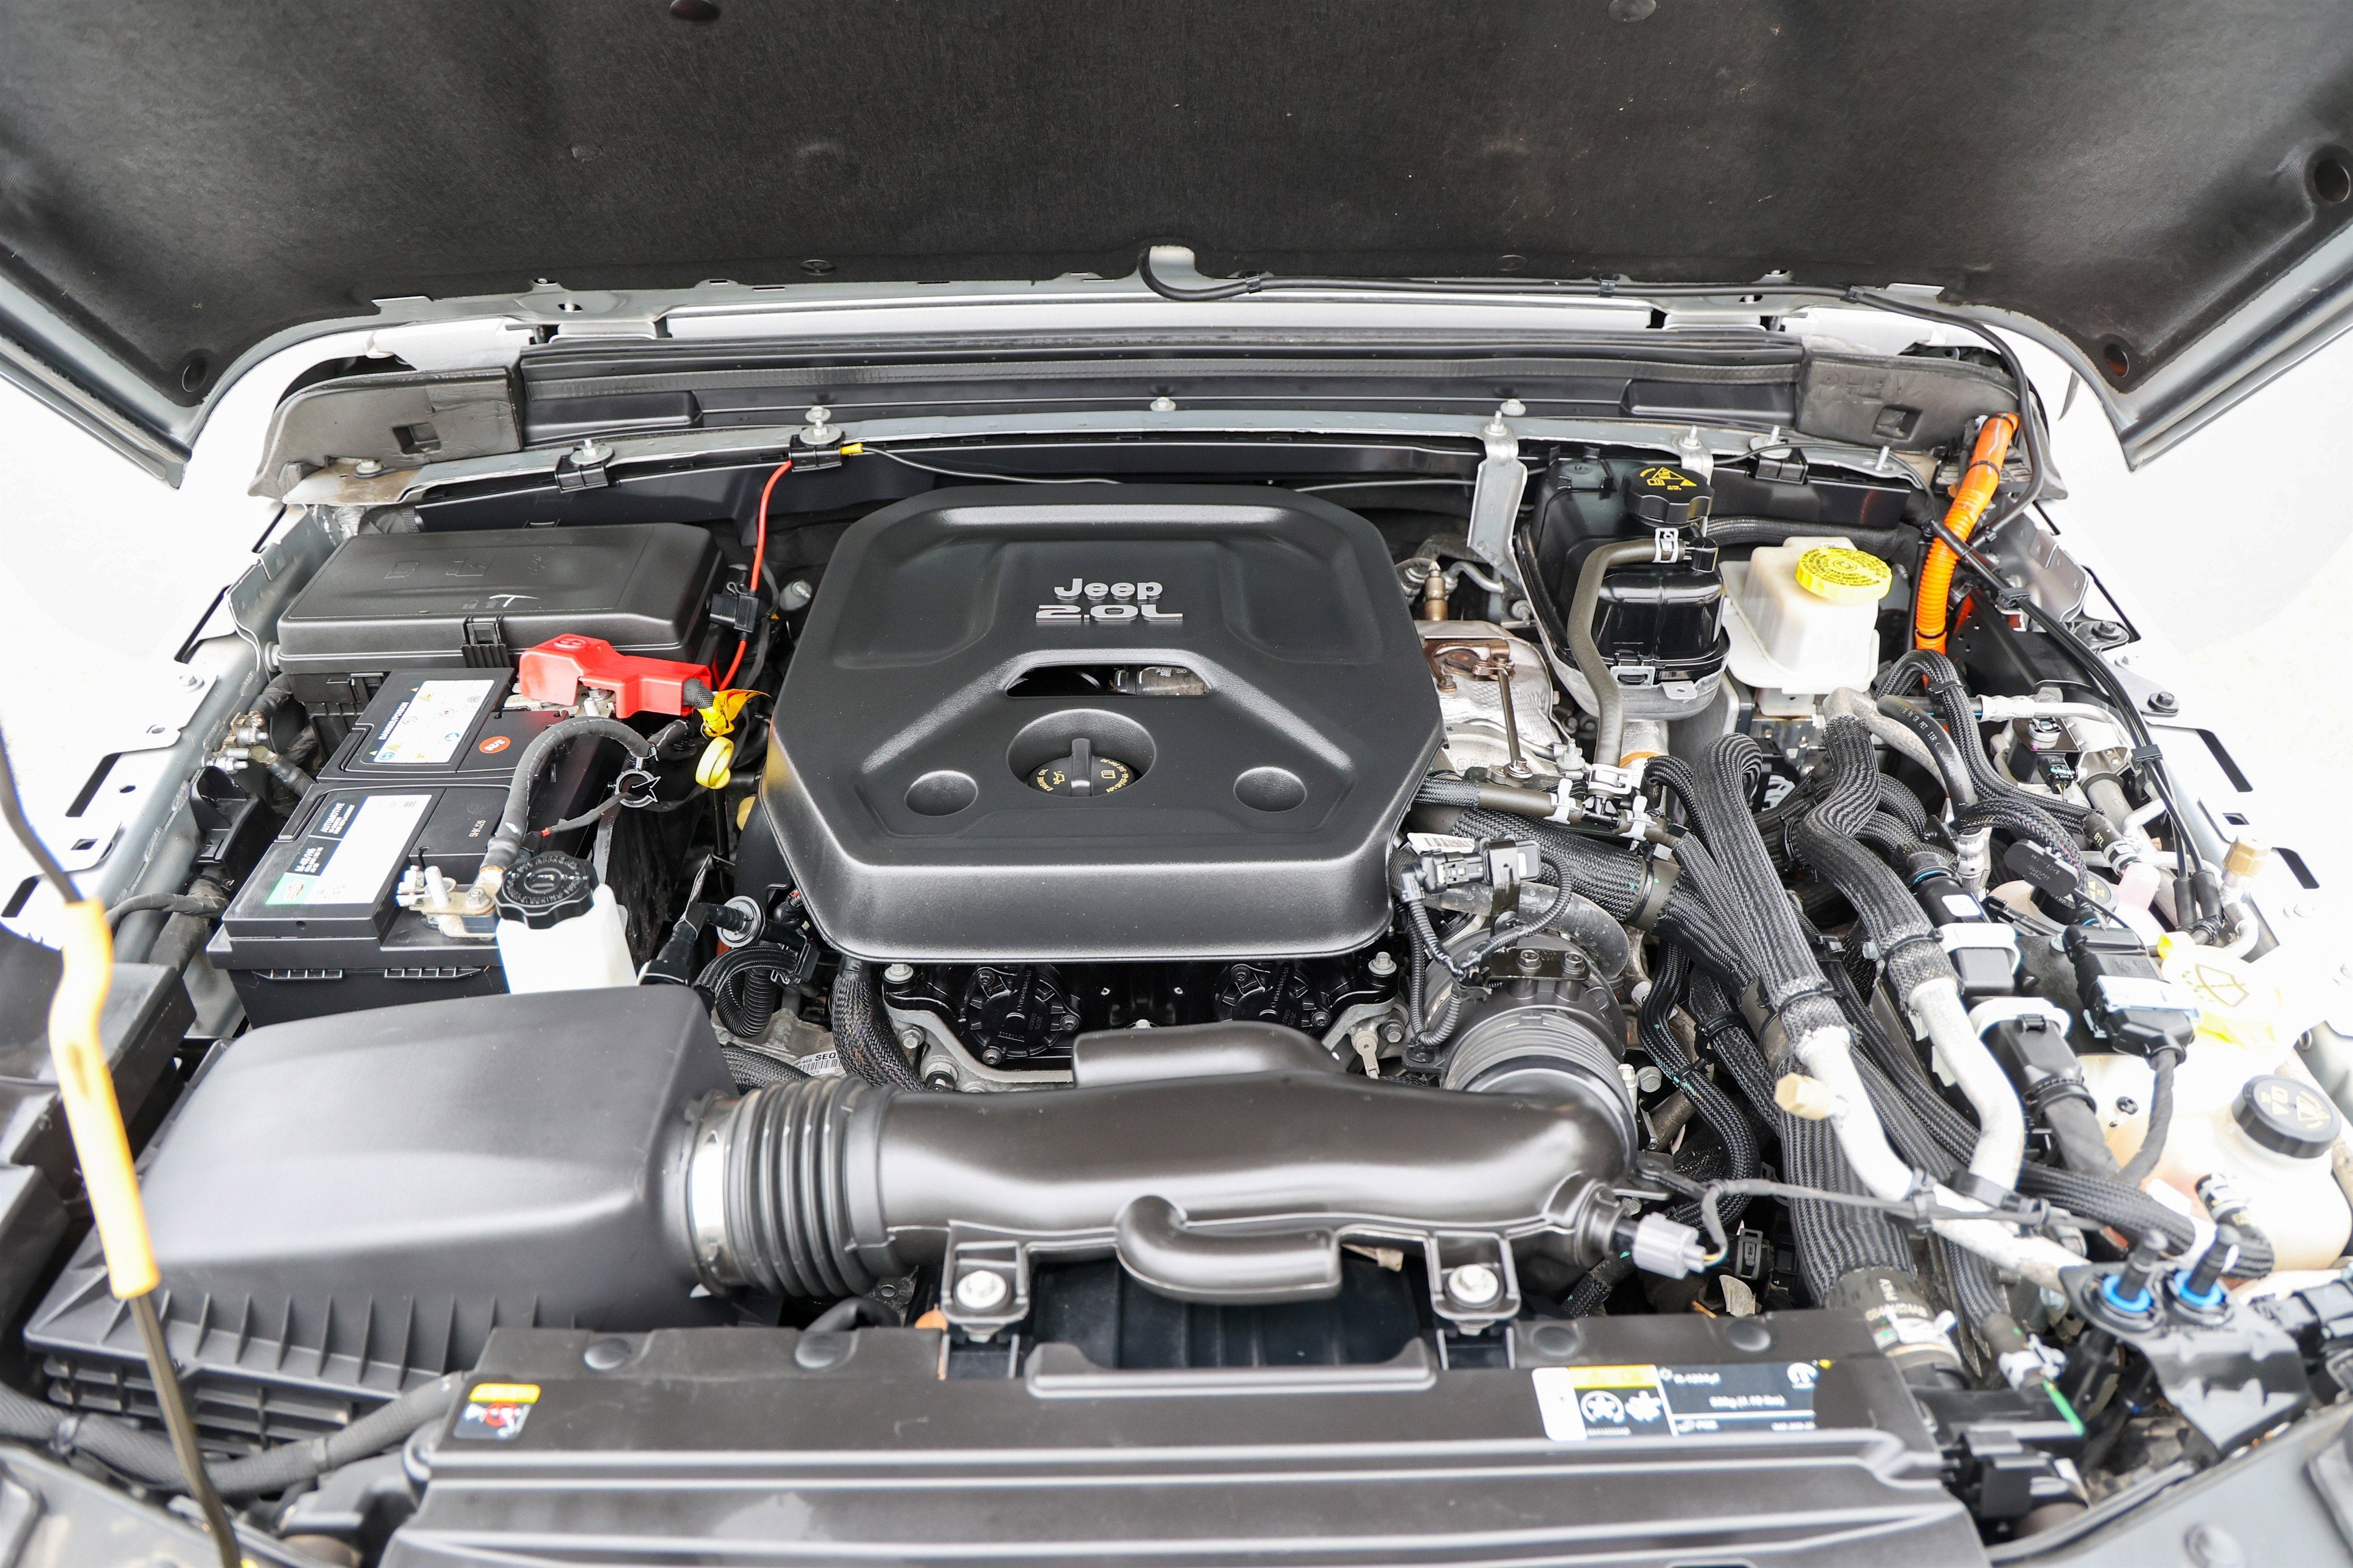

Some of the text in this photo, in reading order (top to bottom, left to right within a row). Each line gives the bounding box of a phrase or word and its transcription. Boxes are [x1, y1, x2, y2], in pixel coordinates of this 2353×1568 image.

[1054, 578, 1163, 601] Jeep
[1036, 604, 1183, 622] 2.0L
[1919, 721, 1928, 730] PET
[1037, 777, 1054, 791] ENGINE
[320, 802, 345, 833] AUTOMOTIVE
[2094, 832, 2105, 847] BTL
